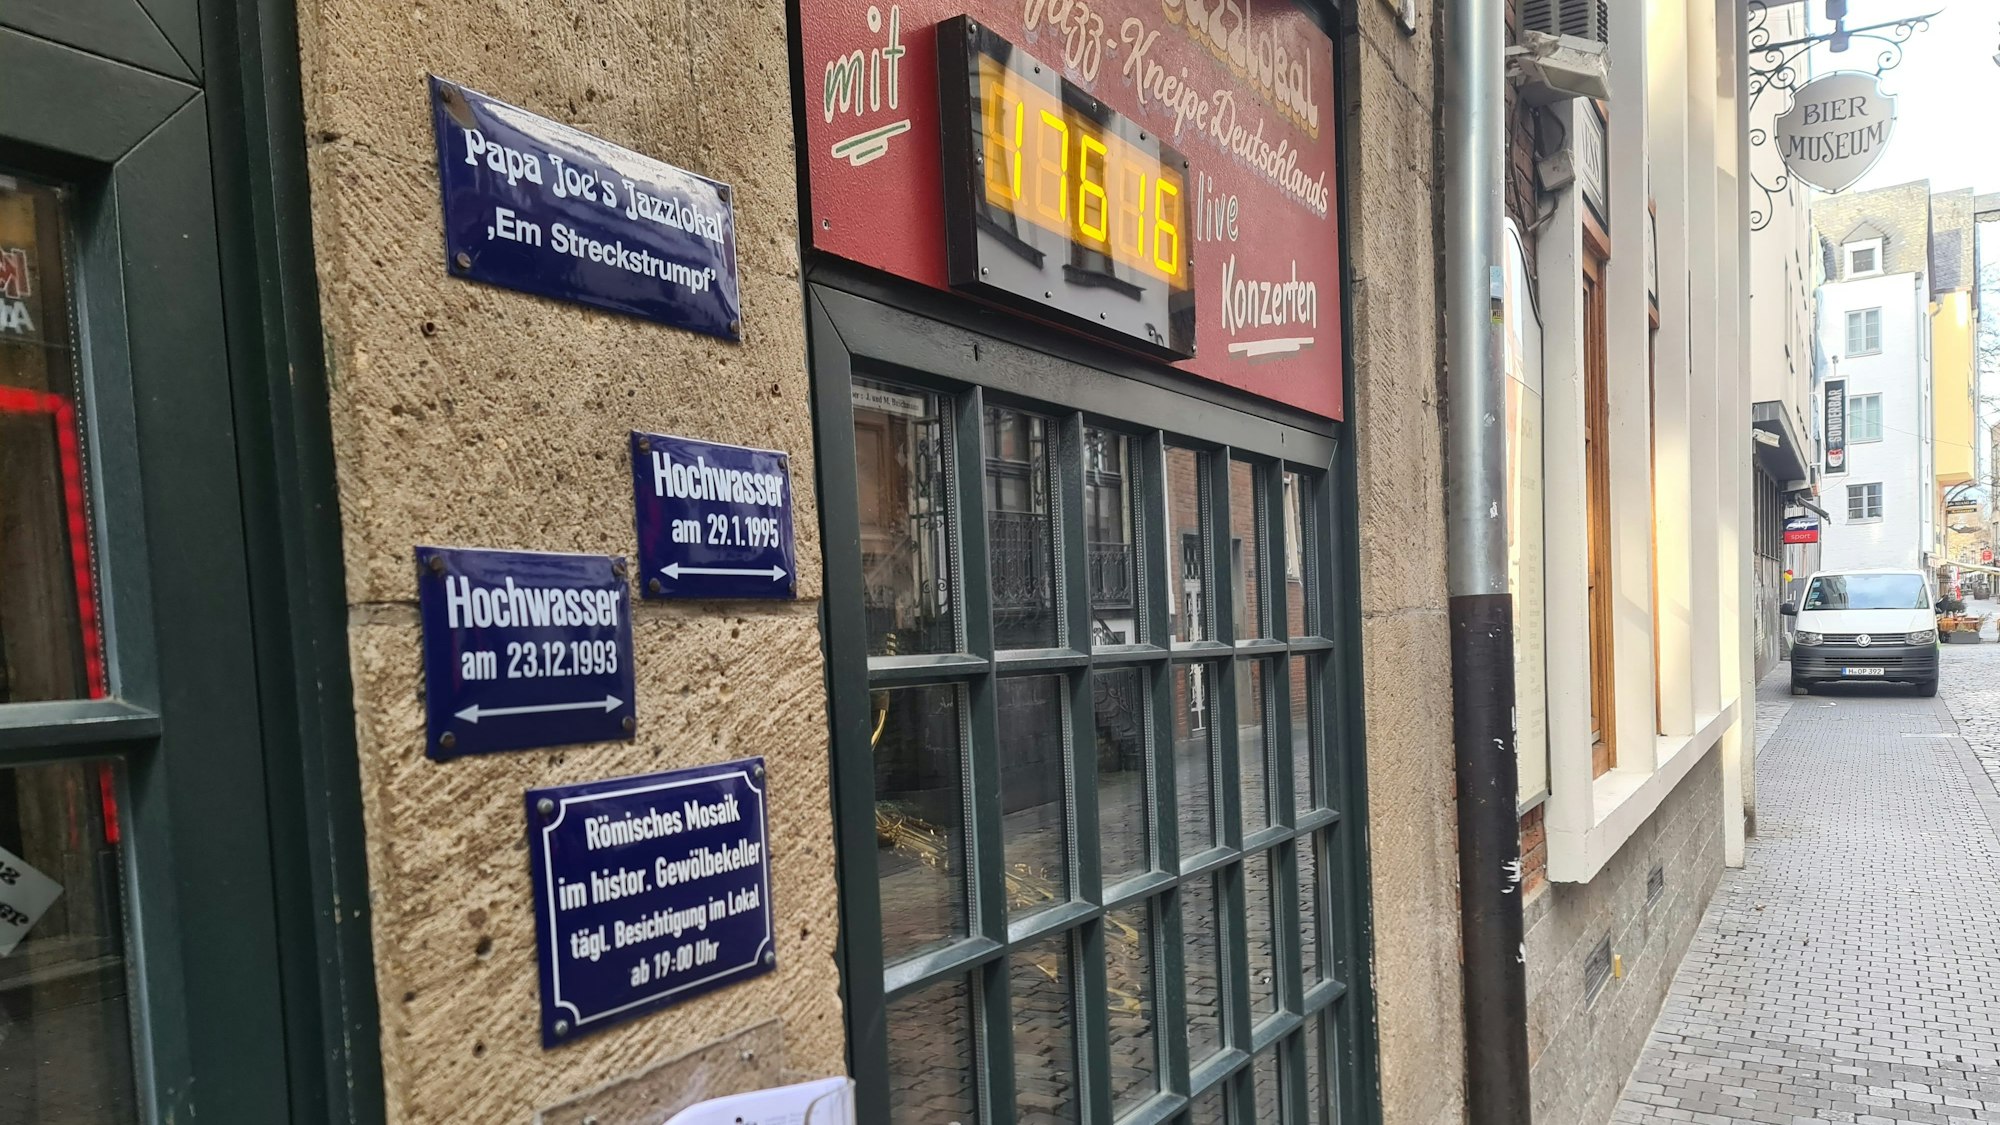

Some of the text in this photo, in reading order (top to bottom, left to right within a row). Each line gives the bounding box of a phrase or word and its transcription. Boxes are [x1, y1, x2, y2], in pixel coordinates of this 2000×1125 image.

[824, 6, 906, 123] mit
[1803, 96, 1868, 126] BIER
[1210, 89, 1329, 214] Deutschlands
[1786, 120, 1885, 163] MUSEUM
[463, 128, 724, 245] Papa Joe's Jazzlokal
[1197, 170, 1239, 242] live
[1221, 253, 1317, 337] Konzerten
[1828, 388, 1842, 443] SONDERBAR
[652, 451, 784, 508] Hochwasser
[672, 514, 779, 549] am 29.1.1995
[1791, 533, 1812, 542] sport
[446, 576, 620, 629] Hochwasser
[461, 641, 618, 681] am 23.12.1993
[585, 794, 740, 850] Römisches Mosaik
[558, 841, 761, 911] im histor. Gewölbekeller
[570, 884, 760, 962] tägl. Besichtigung im Lokal
[630, 940, 720, 988] ab 19:00 Uhr
